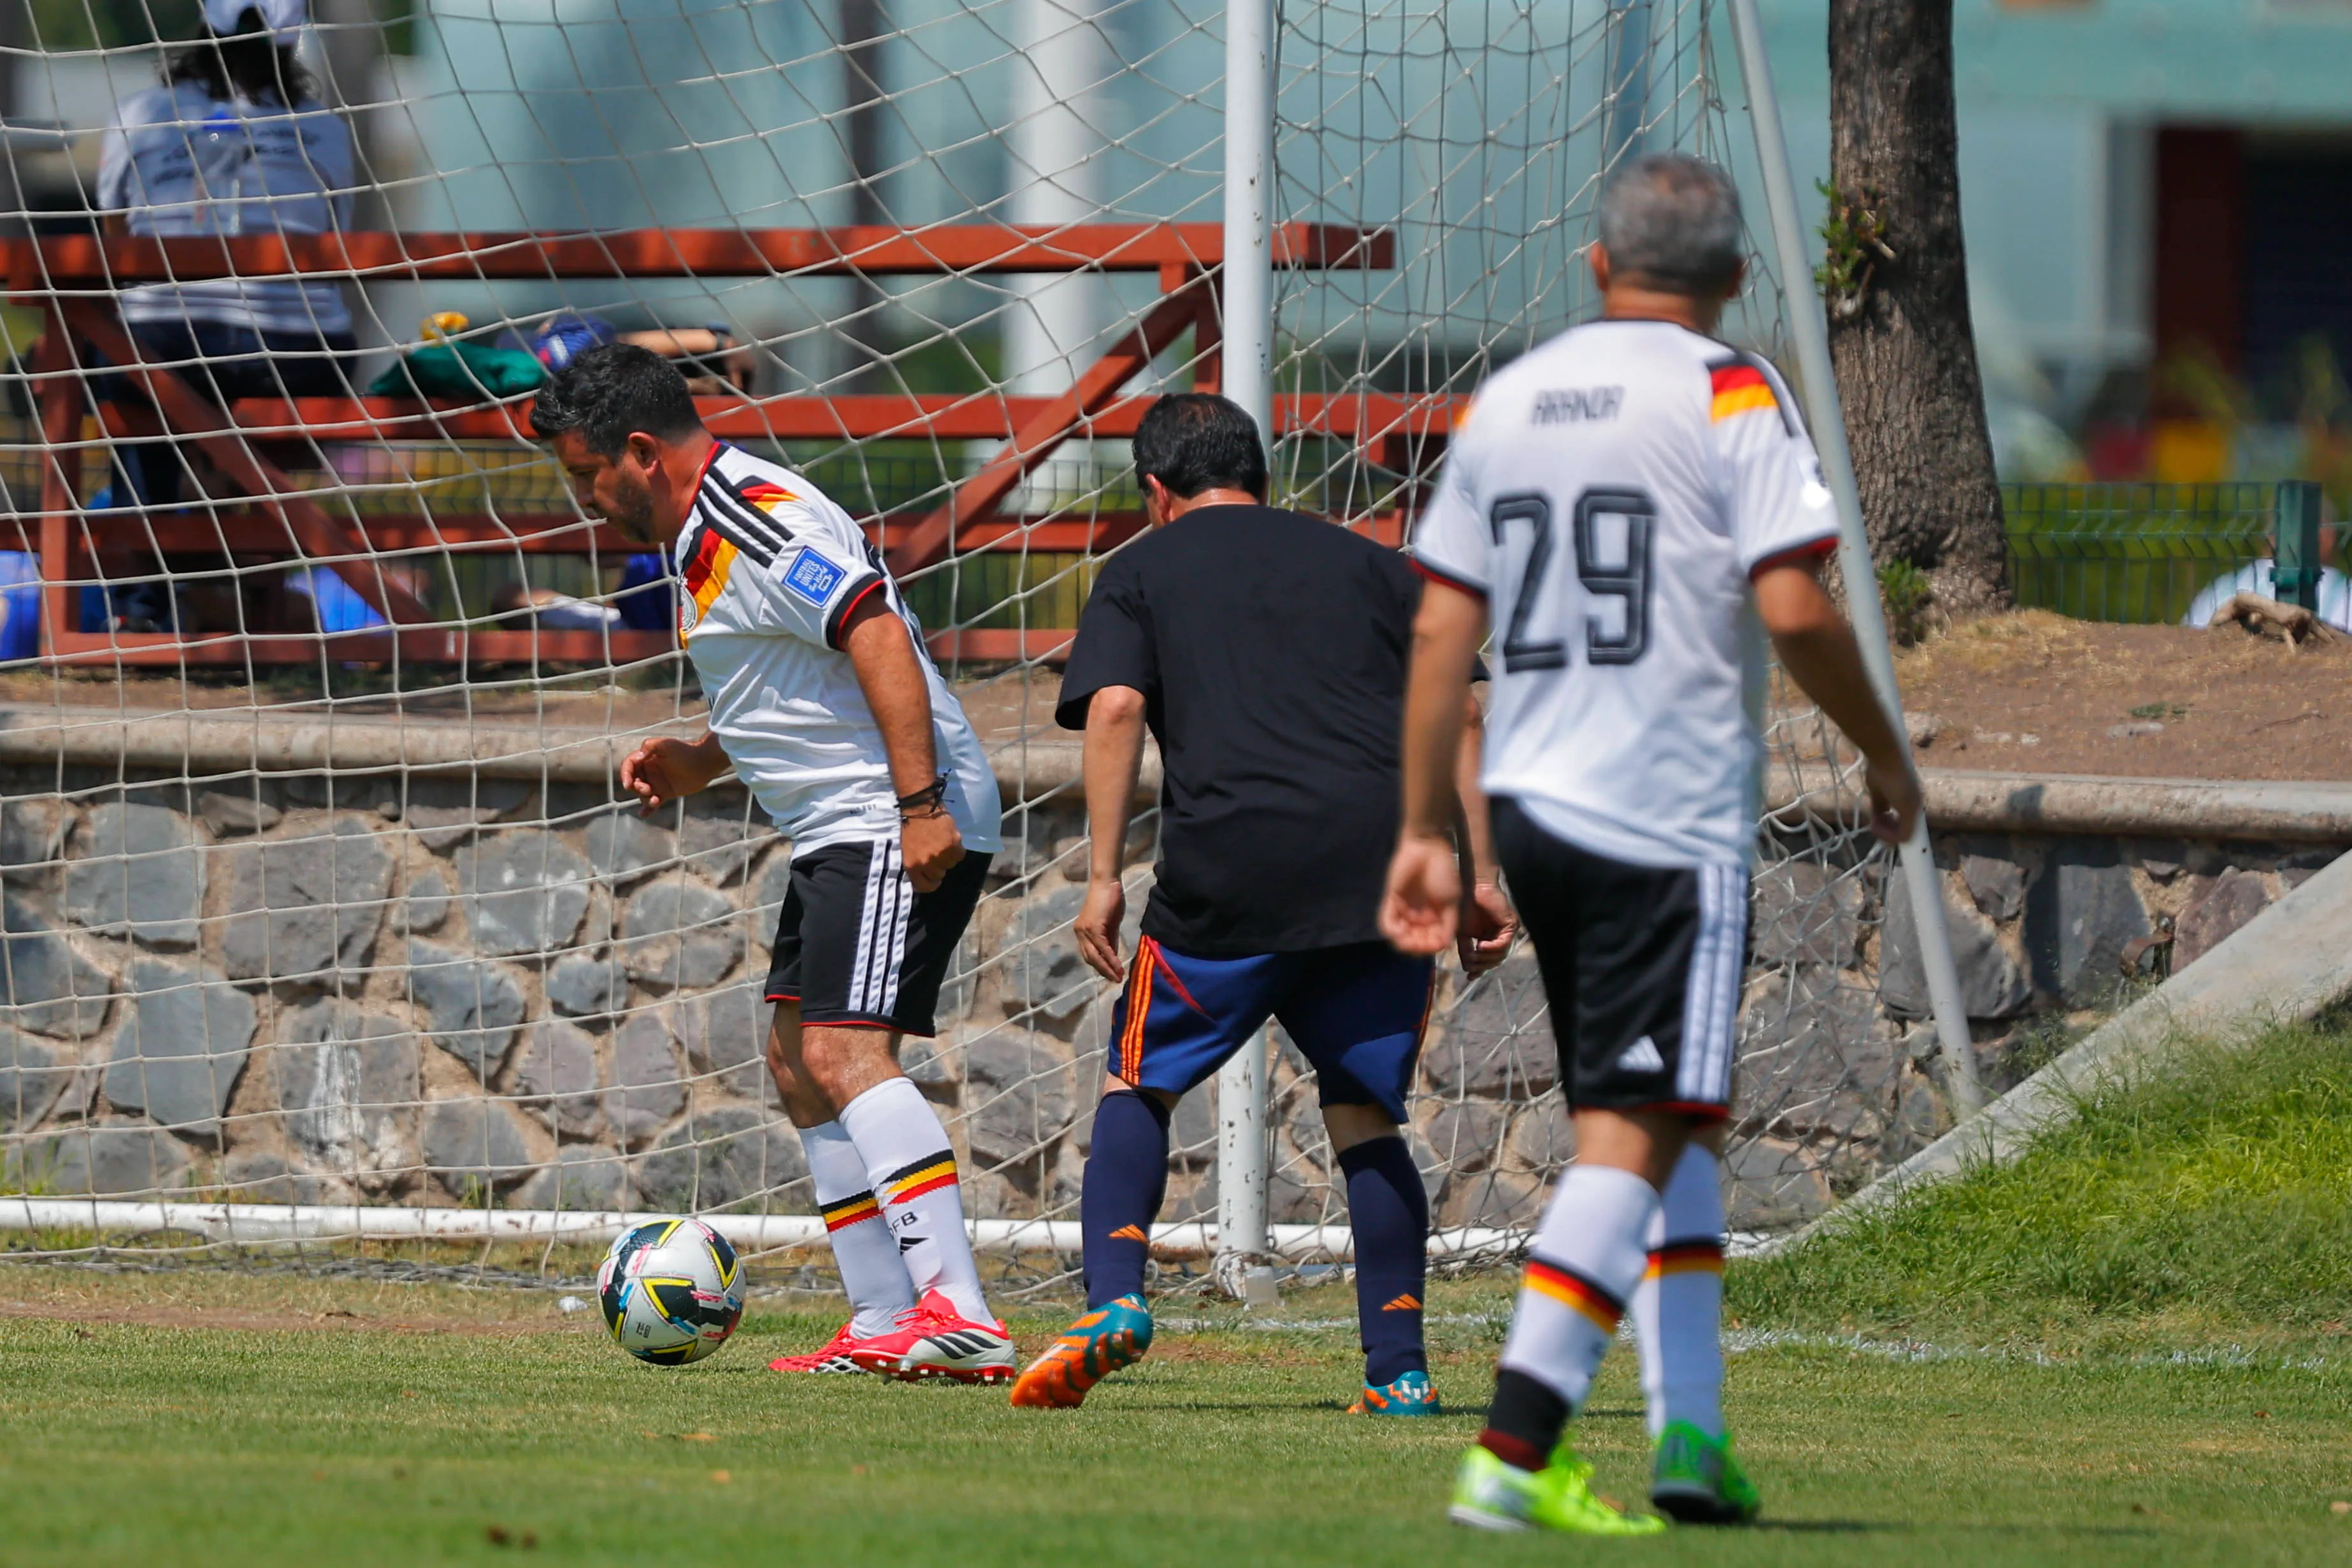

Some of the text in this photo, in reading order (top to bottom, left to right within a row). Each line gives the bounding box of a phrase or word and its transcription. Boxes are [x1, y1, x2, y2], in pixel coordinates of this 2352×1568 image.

[794, 558, 811, 581] FOOTBALL
[800, 560, 820, 586] UNITES
[1491, 485, 1657, 674] 29
[821, 578, 829, 589] FIFA
